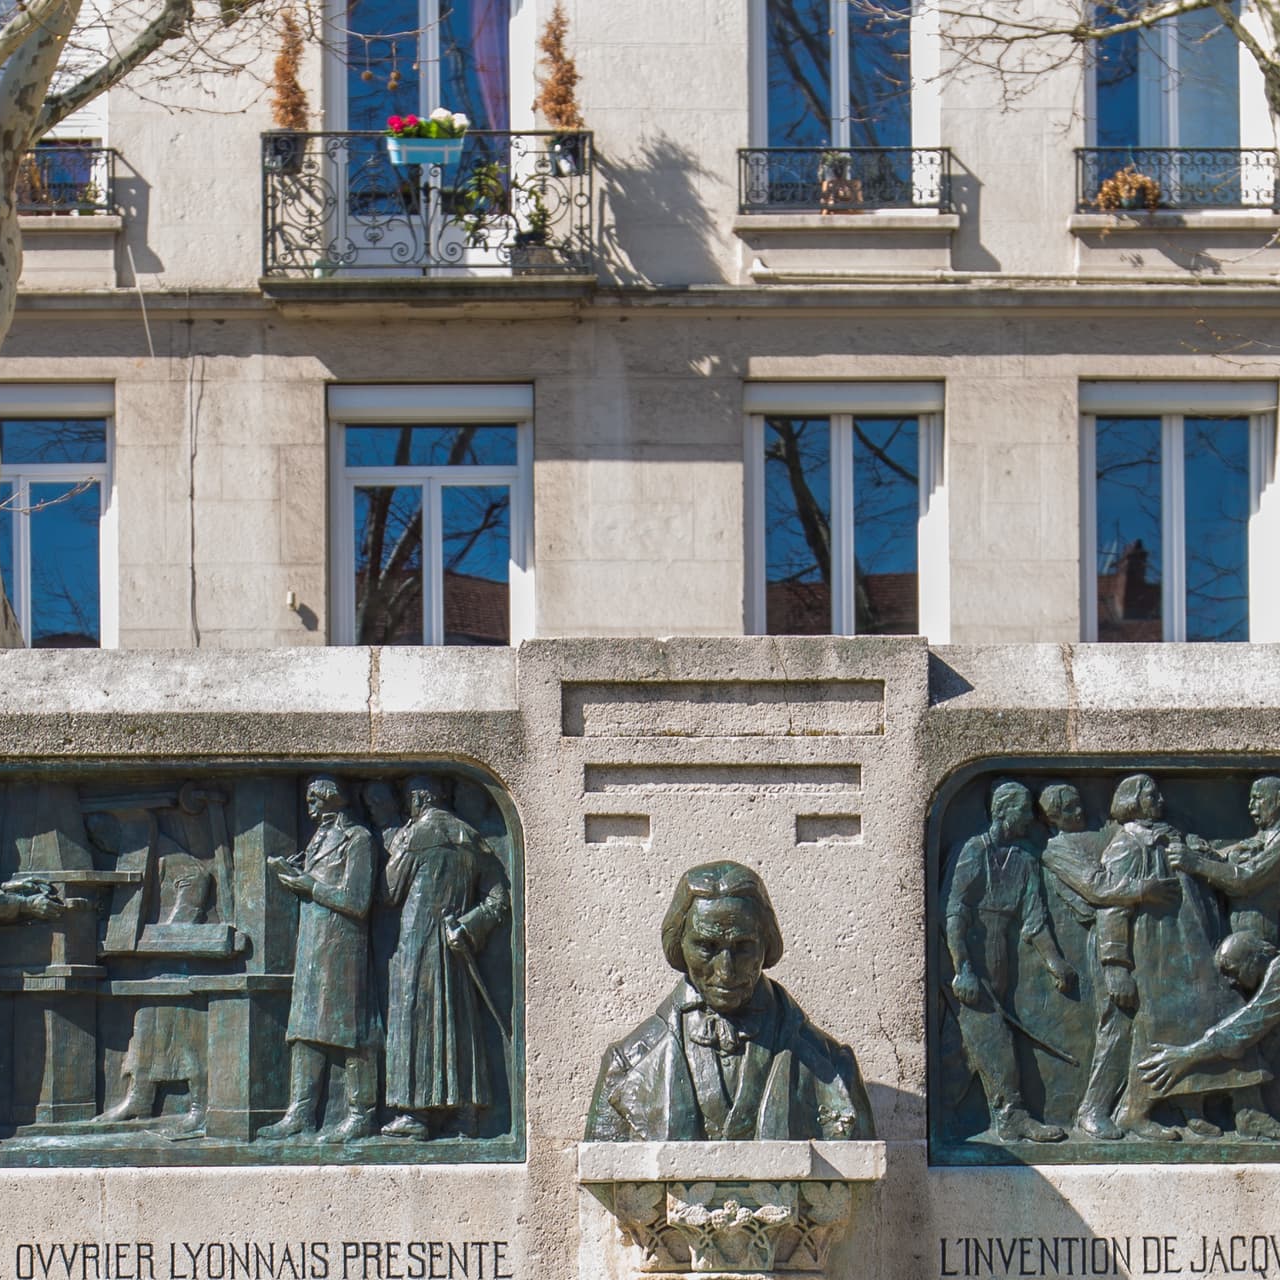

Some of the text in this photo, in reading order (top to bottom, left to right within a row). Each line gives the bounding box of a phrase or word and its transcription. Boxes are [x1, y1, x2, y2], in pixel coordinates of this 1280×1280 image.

[15, 1241, 156, 1280] OVVRIER
[170, 1241, 330, 1280] LYONNAIS
[341, 1240, 514, 1280] PRESENTE
[940, 1236, 1131, 1276] L'INVENTION
[1142, 1236, 1183, 1274] DE
